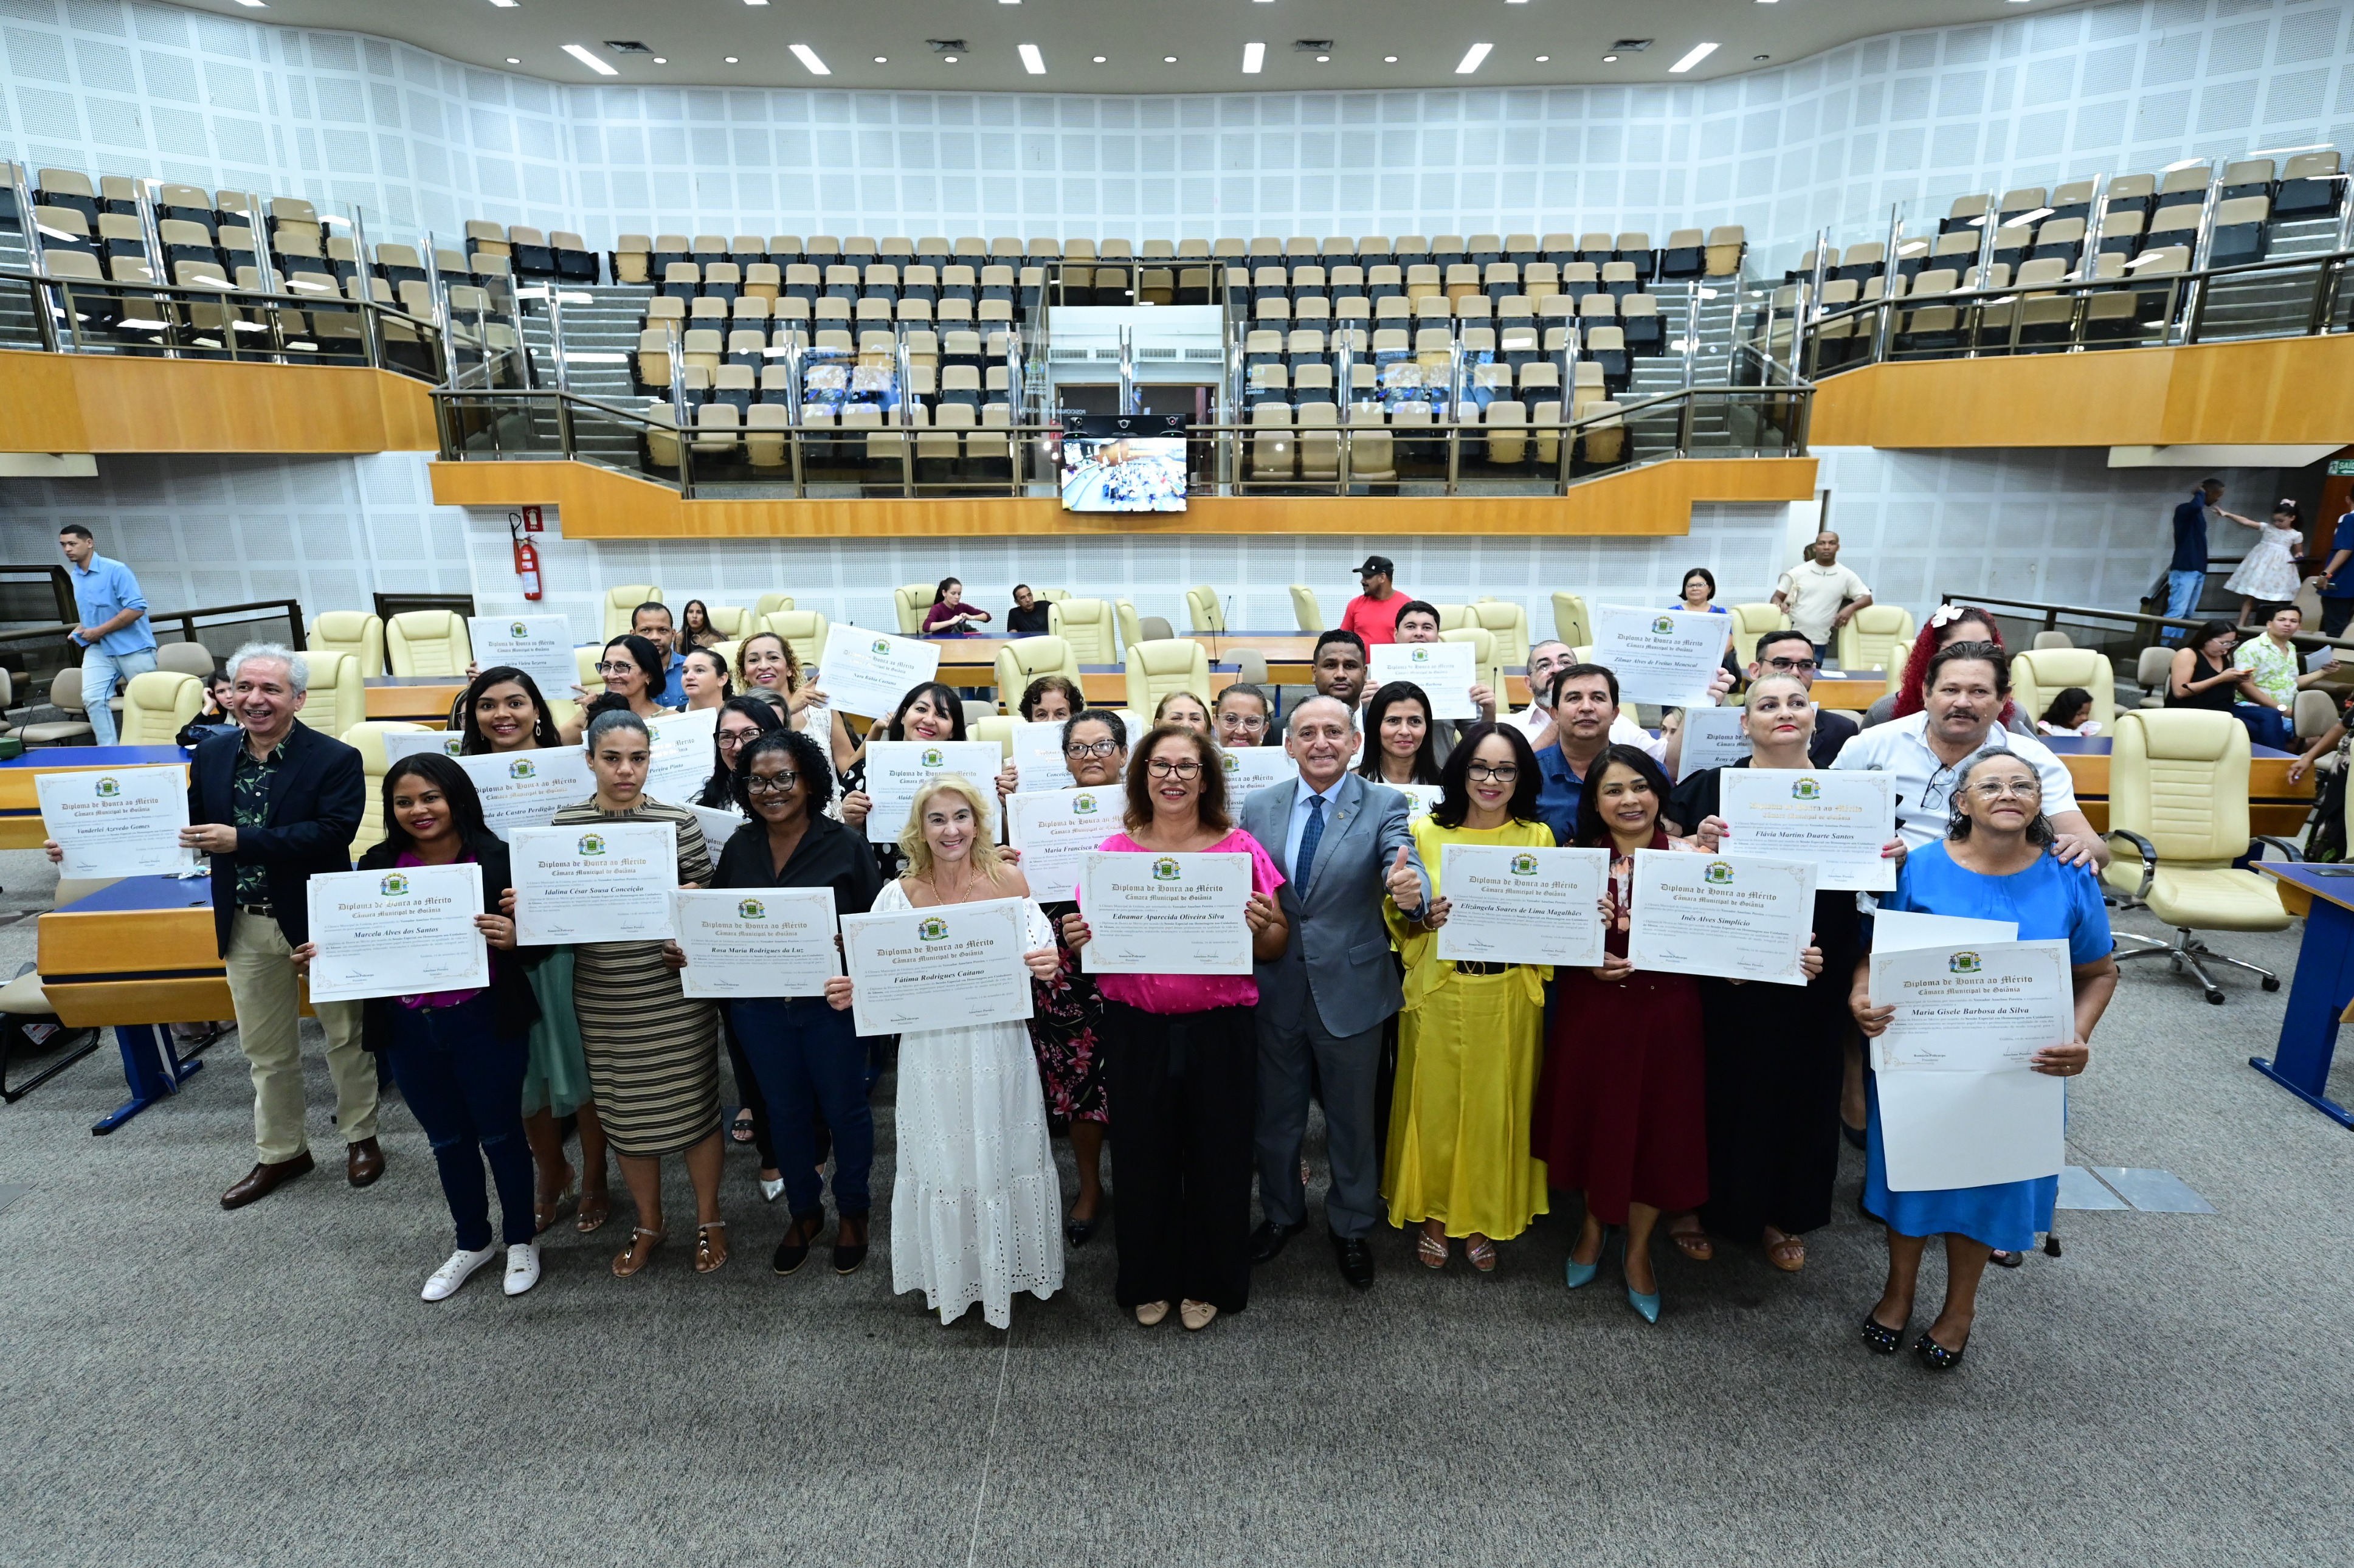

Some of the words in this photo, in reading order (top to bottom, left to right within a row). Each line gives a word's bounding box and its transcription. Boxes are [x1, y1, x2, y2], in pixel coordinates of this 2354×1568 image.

[1469, 876, 1501, 885] Diploma
[1514, 879, 1538, 887] Honra
[1661, 883, 1694, 893] Diploma
[1708, 888, 1733, 896] Honra
[1748, 891, 1776, 900] Mérito
[1717, 917, 1750, 927] Simplício
[877, 948, 911, 956] Diploma
[925, 944, 951, 953] Honra
[966, 939, 993, 948] Mérito
[921, 972, 955, 981] Rodrigues
[1904, 979, 1940, 988] Diploma
[2001, 975, 2032, 984] Mérito
